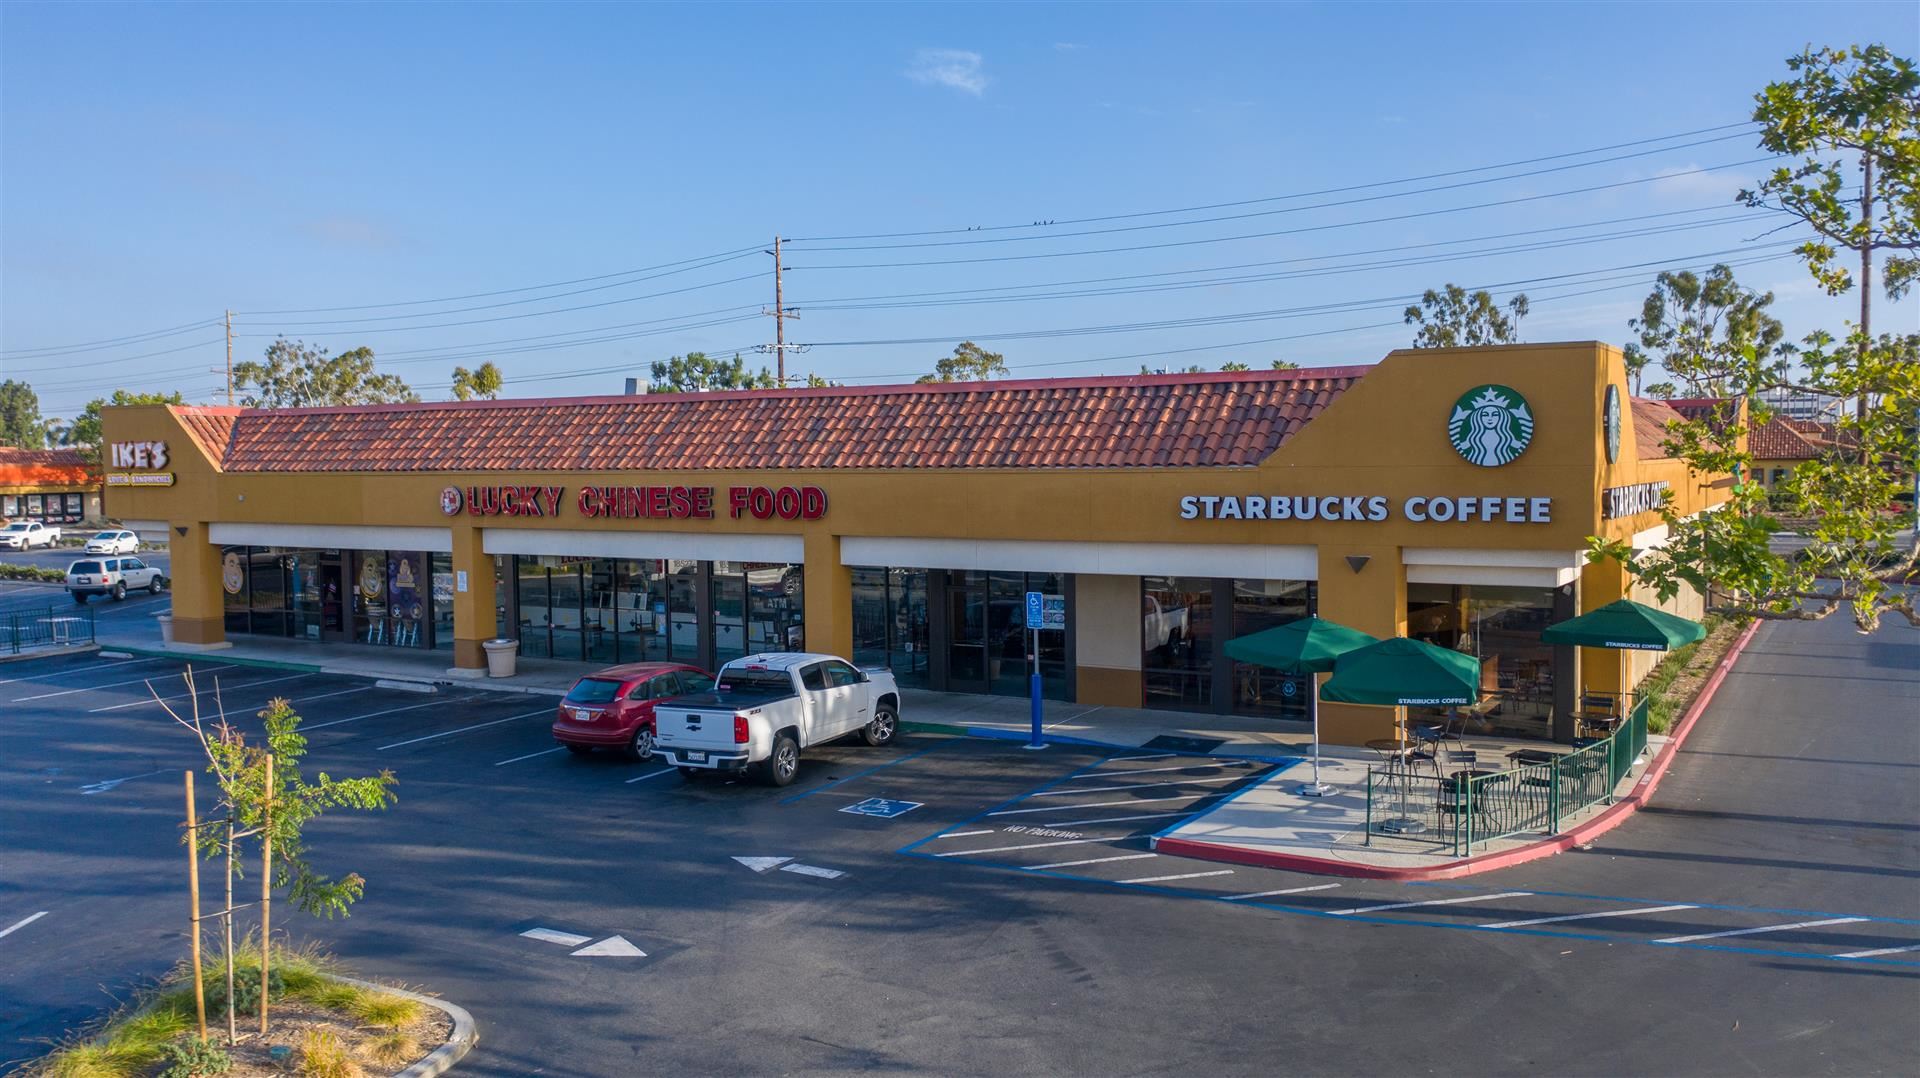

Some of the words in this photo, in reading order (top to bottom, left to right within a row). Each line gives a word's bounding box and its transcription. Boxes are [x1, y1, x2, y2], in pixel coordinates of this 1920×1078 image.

[111, 440, 168, 469] IKE'S
[467, 485, 563, 516] LUCKY
[577, 485, 714, 518] CHINESE
[729, 486, 827, 520] FOOD
[1180, 495, 1389, 521] STARBUCKS
[1404, 496, 1551, 523] COFFEE
[1610, 483, 1650, 520] STARBUCKS
[767, 597, 787, 609] ATM
[1002, 824, 1027, 833] NO
[1025, 827, 1084, 839] PARKING
